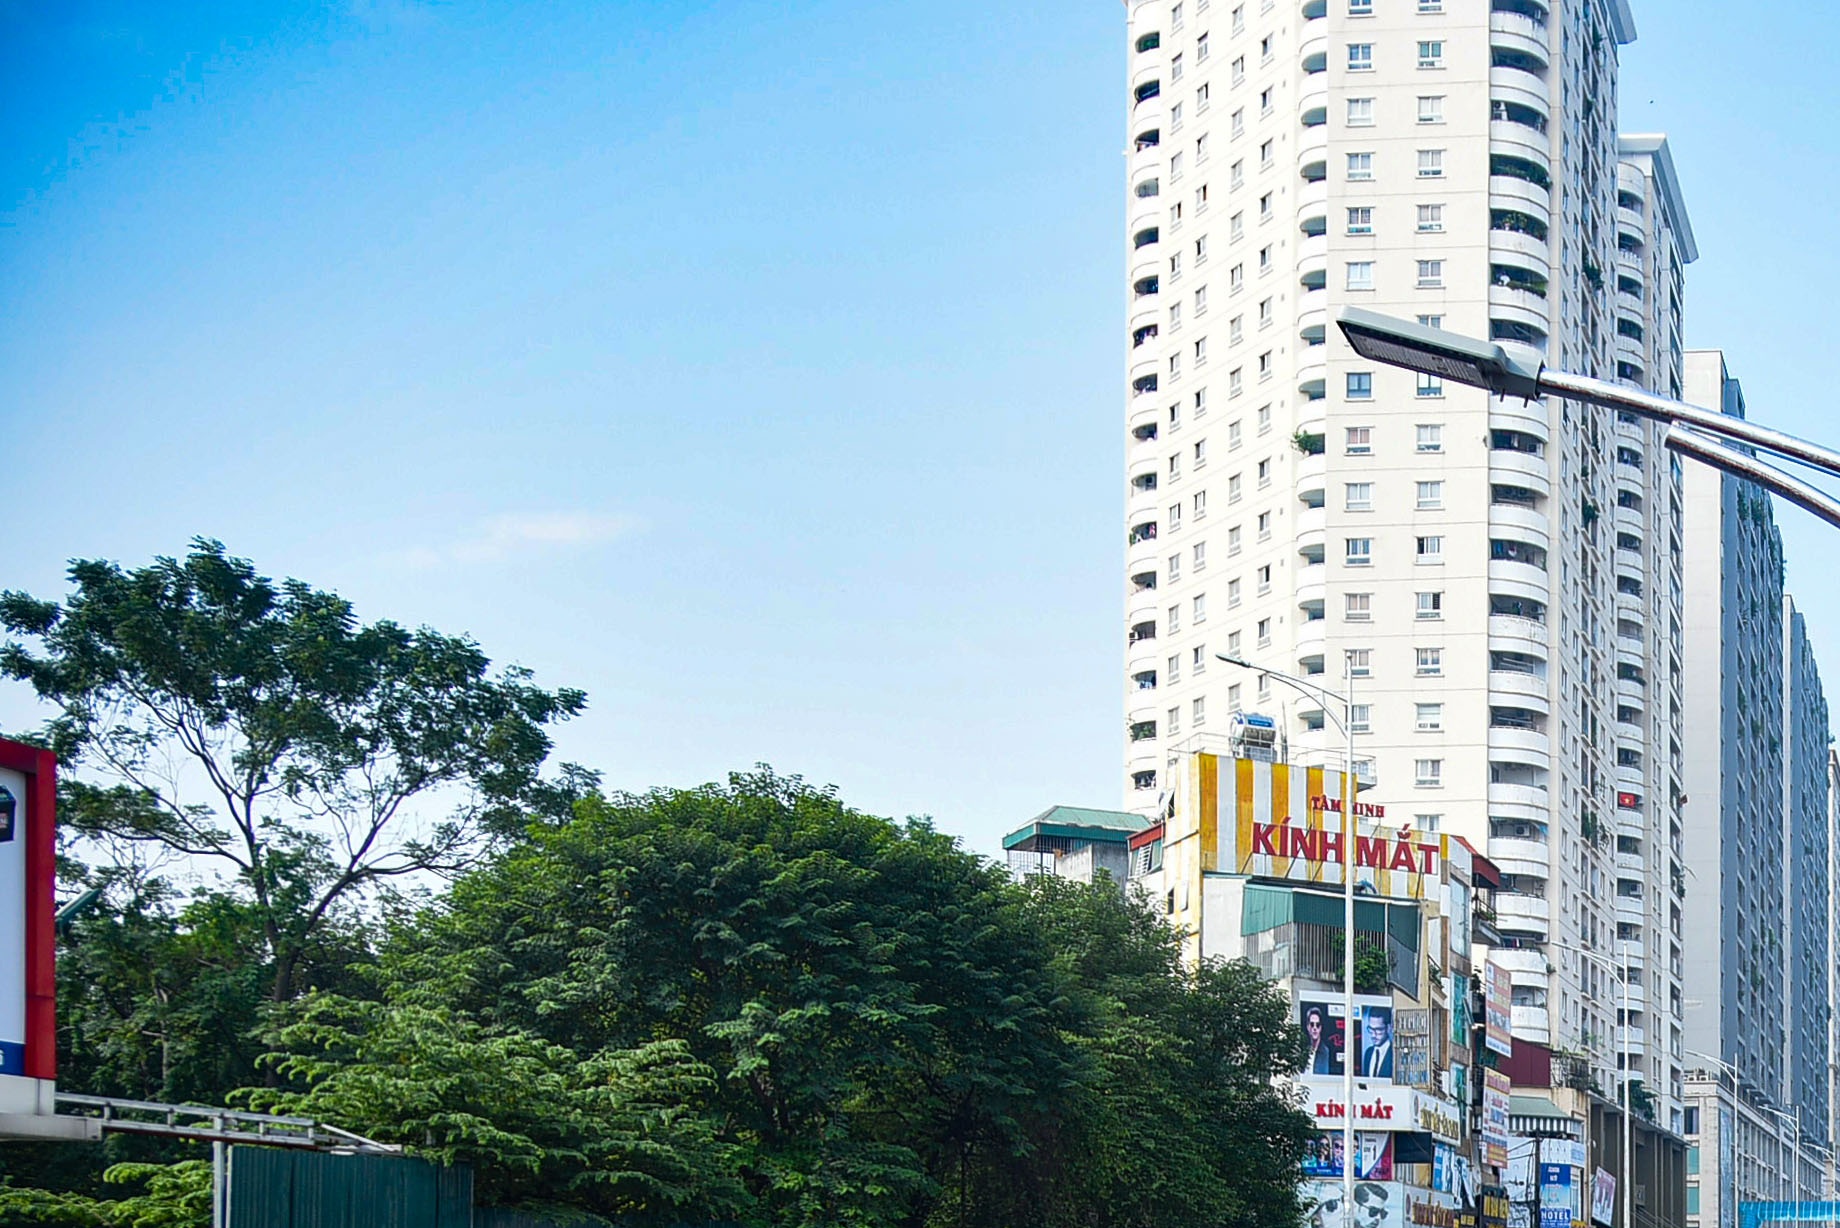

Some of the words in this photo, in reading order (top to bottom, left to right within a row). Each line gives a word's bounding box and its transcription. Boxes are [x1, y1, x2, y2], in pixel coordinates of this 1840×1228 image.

[1252, 816, 1345, 863] KÍNH
[1356, 823, 1439, 874] MẮT
[1316, 1098, 1356, 1118] KÍN
[1361, 1097, 1393, 1119] MẮT
